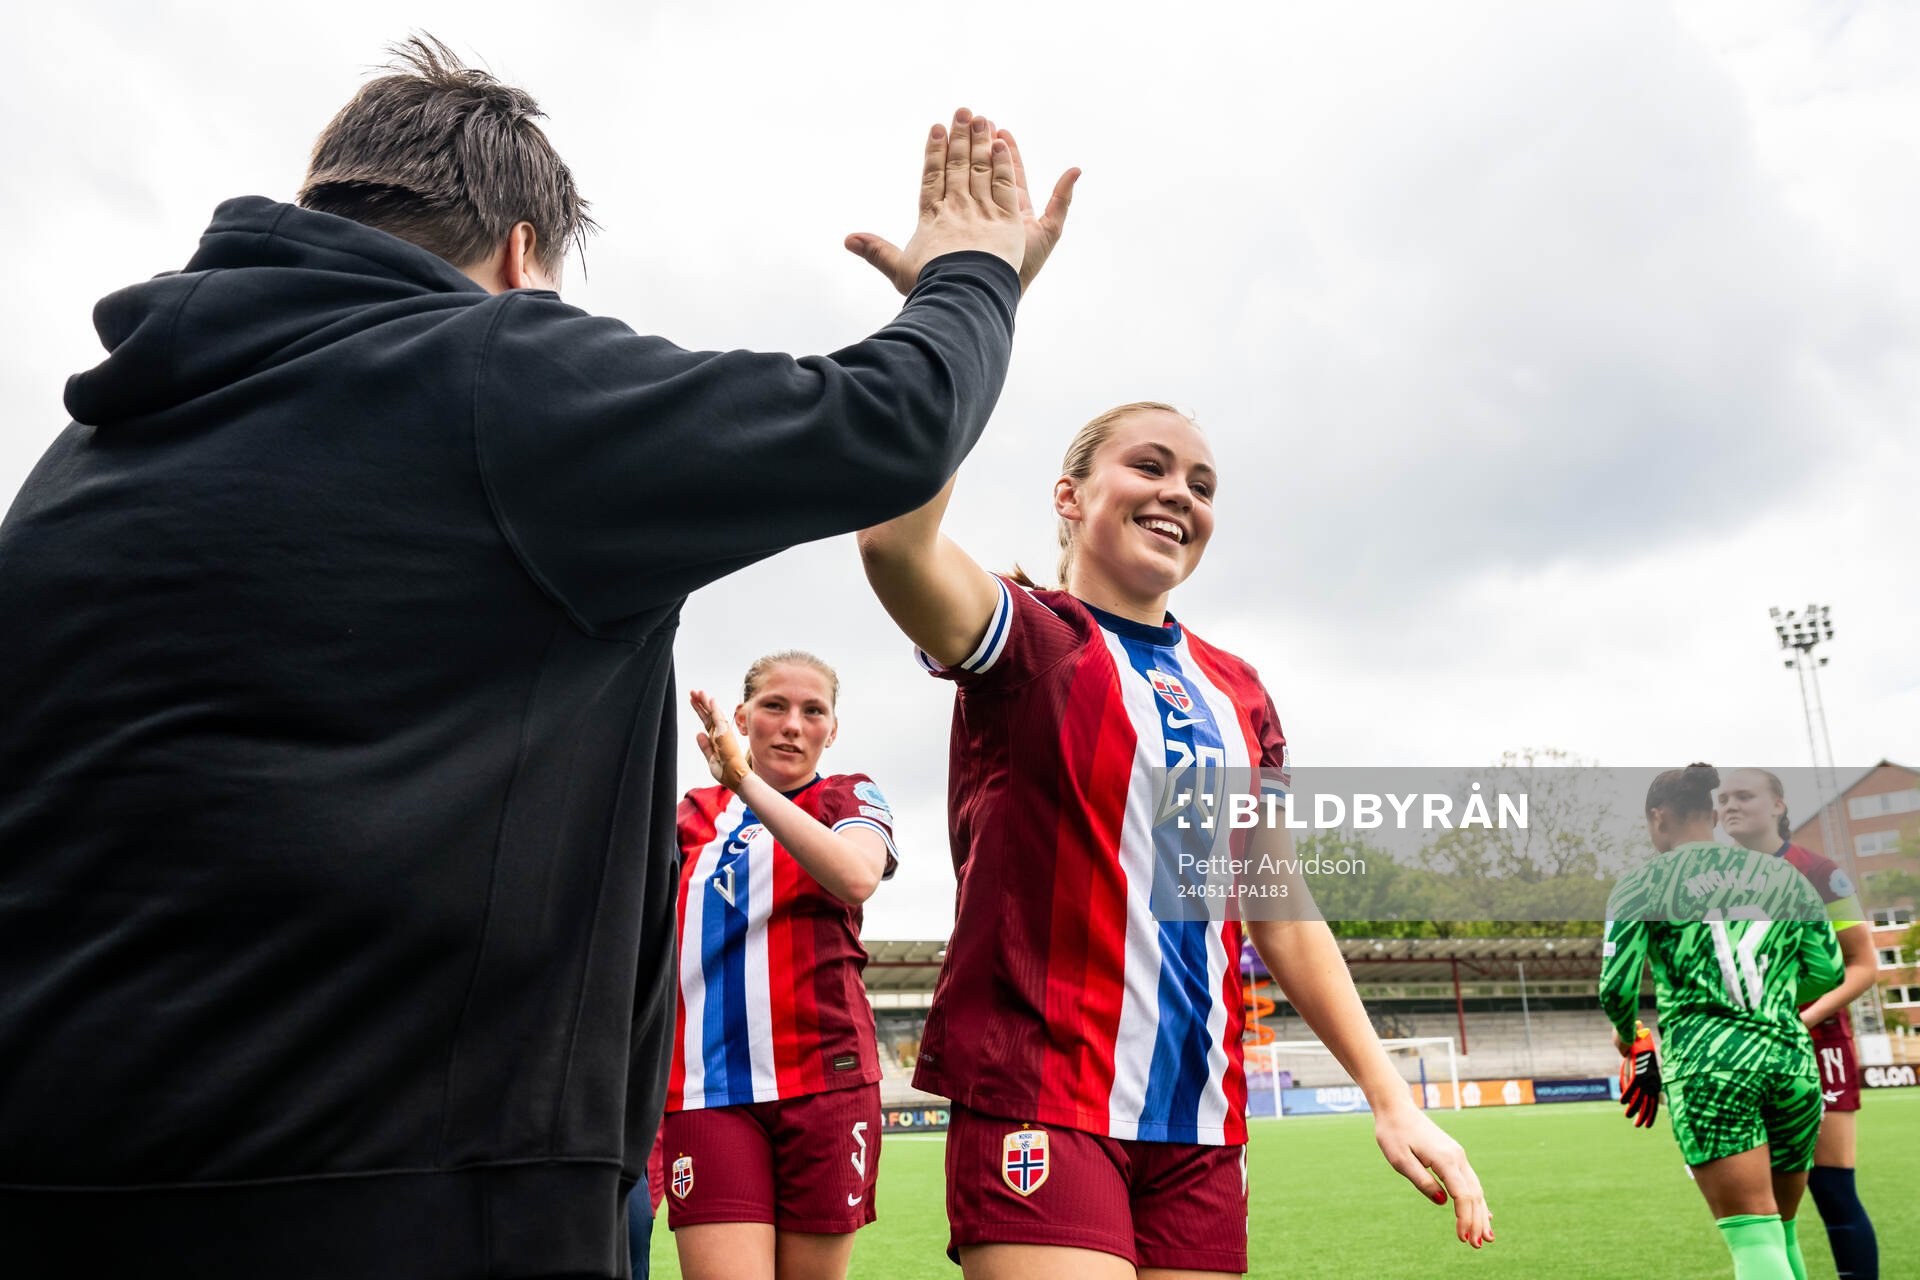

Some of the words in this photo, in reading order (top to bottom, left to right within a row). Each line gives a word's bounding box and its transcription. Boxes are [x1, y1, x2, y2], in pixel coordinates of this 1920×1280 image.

[1152, 739, 1225, 842] 20
[1820, 1046, 1846, 1084] 14
[851, 1122, 868, 1182] 5
